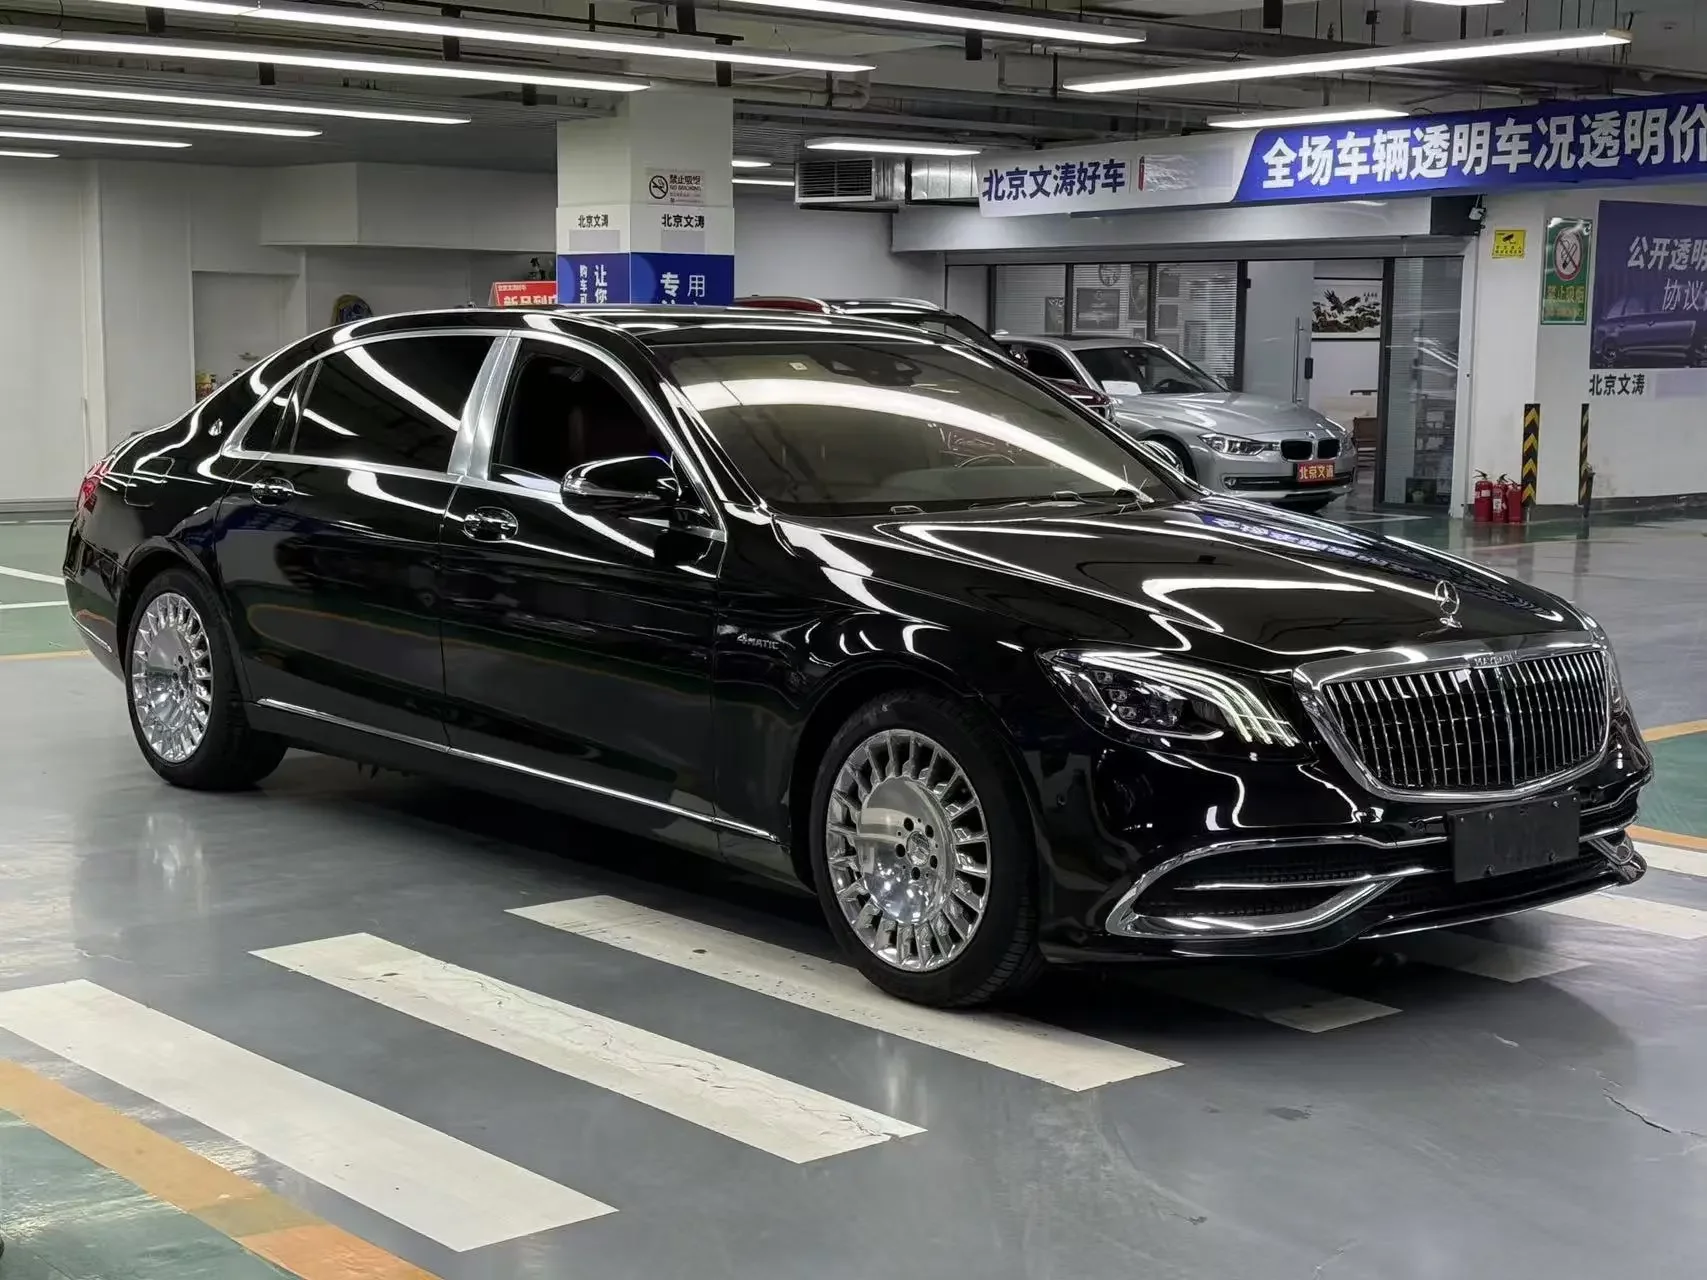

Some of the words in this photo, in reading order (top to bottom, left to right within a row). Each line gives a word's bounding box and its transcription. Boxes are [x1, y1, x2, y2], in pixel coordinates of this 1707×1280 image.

[1262, 103, 1707, 190] 全场车辆透明车况透明价
[982, 158, 1126, 202] 北京文涛好车
[577, 214, 609, 228] 北京文涛
[661, 213, 705, 228] 北京文涛
[1627, 235, 1707, 272] 公开透明
[594, 264, 608, 304] 让你
[1662, 278, 1707, 311] 协议
[1589, 373, 1645, 396] 北京文涛
